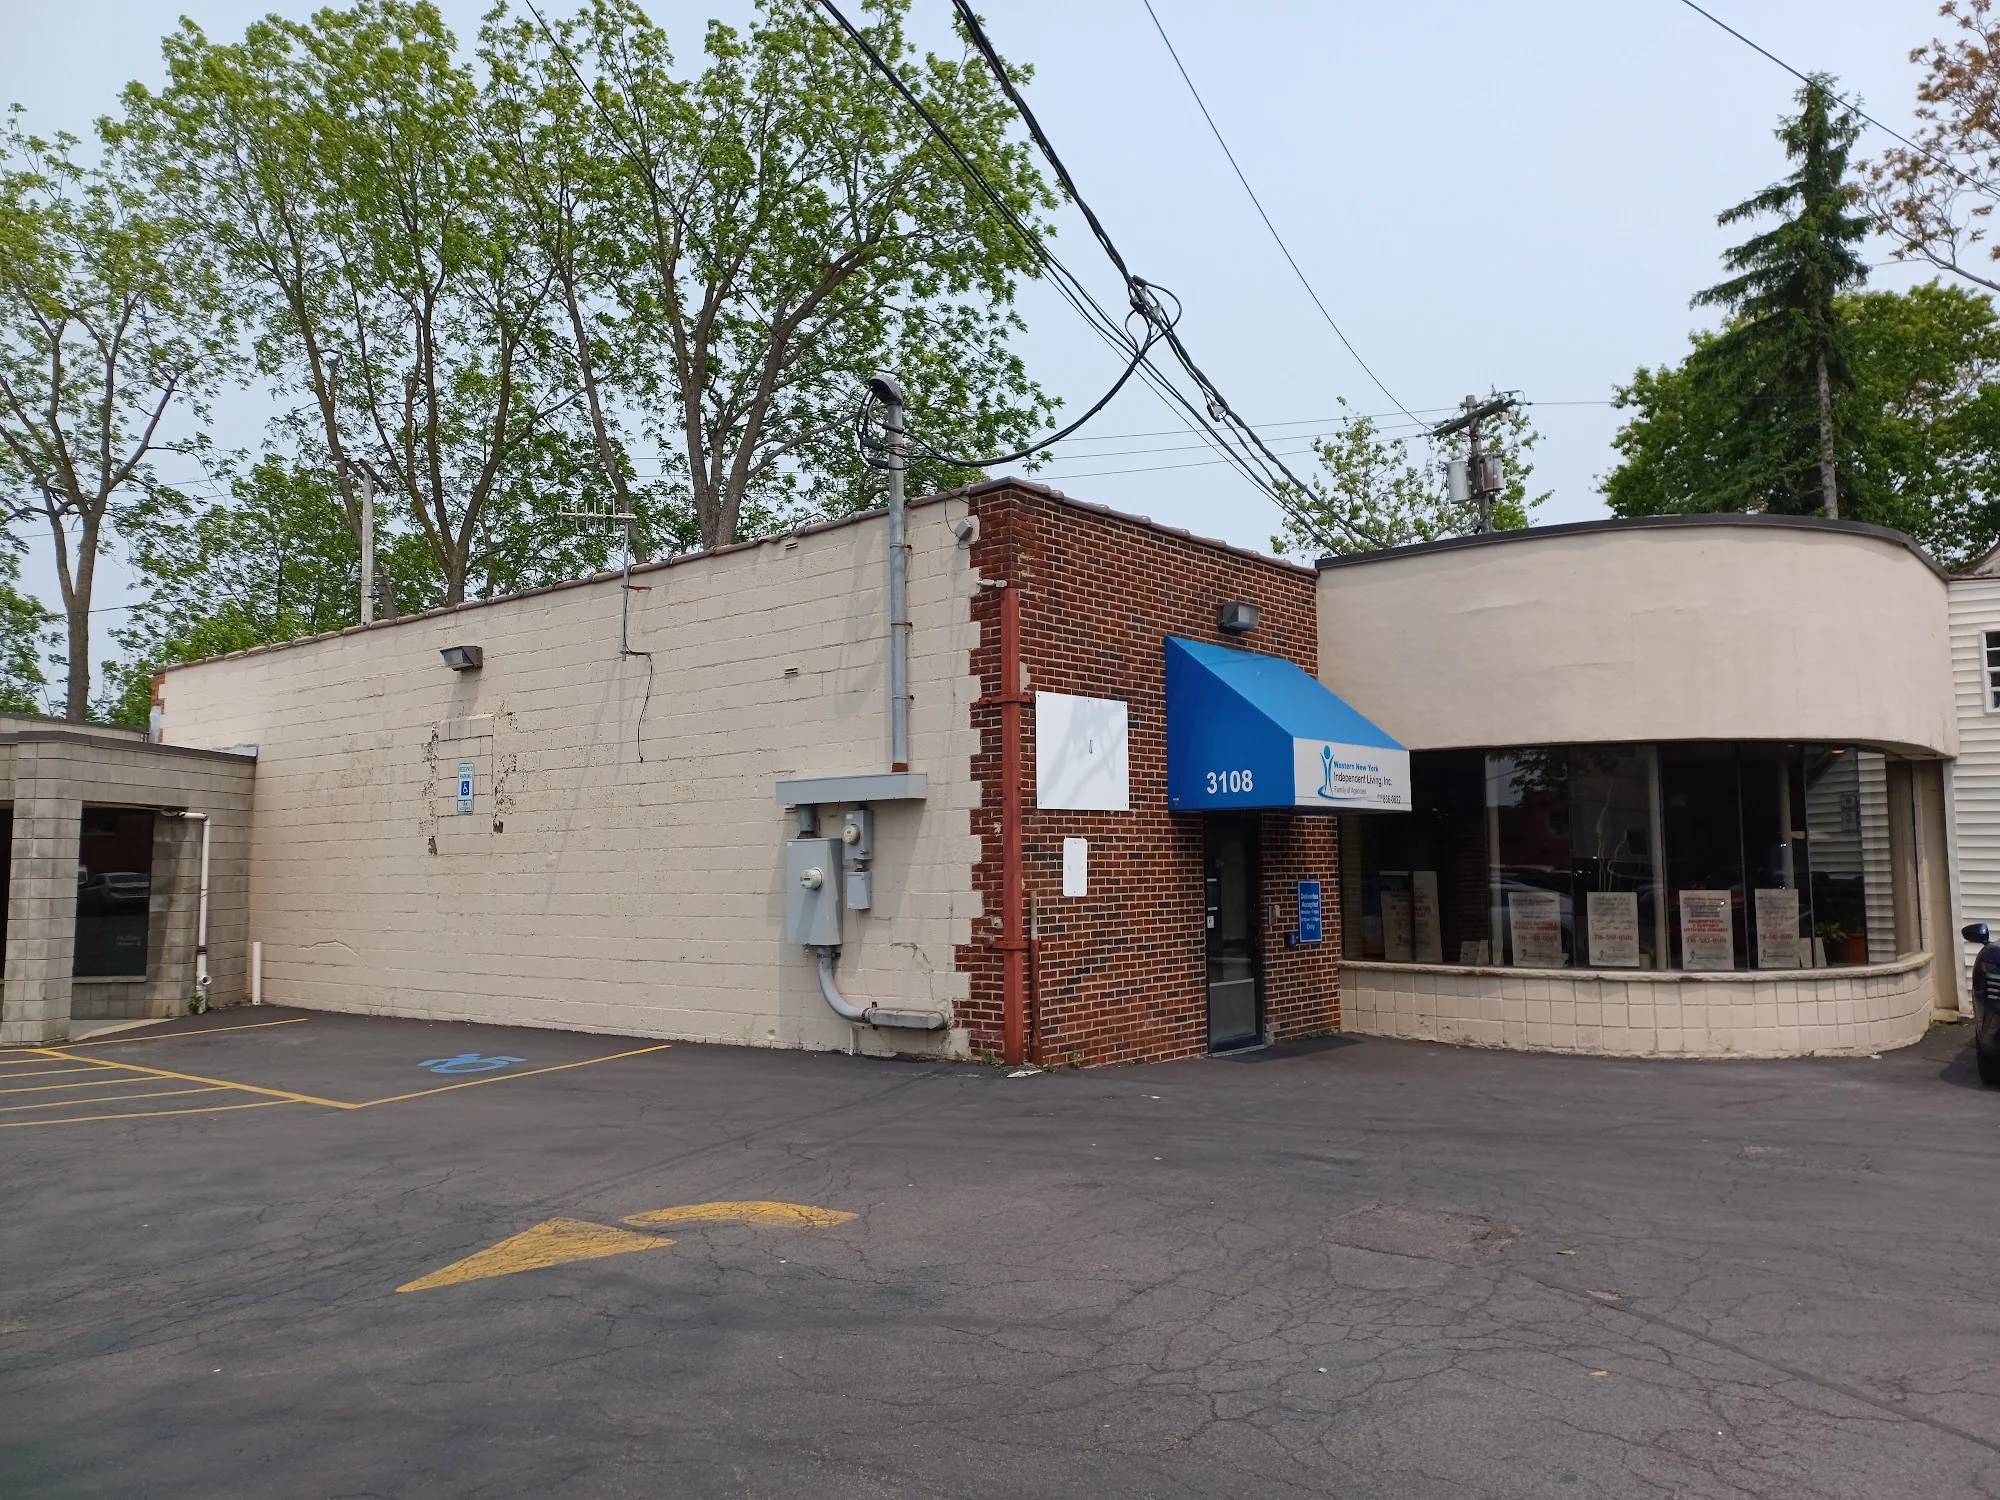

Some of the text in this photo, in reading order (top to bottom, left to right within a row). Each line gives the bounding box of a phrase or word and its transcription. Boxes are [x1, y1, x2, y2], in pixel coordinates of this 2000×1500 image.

[1333, 761, 1379, 772] Western New York
[1206, 770, 1253, 795] 3108
[1333, 771, 1393, 788] Independent Living, Inc.
[1334, 785, 1347, 795] Family
[1351, 787, 1367, 796] Agencies
